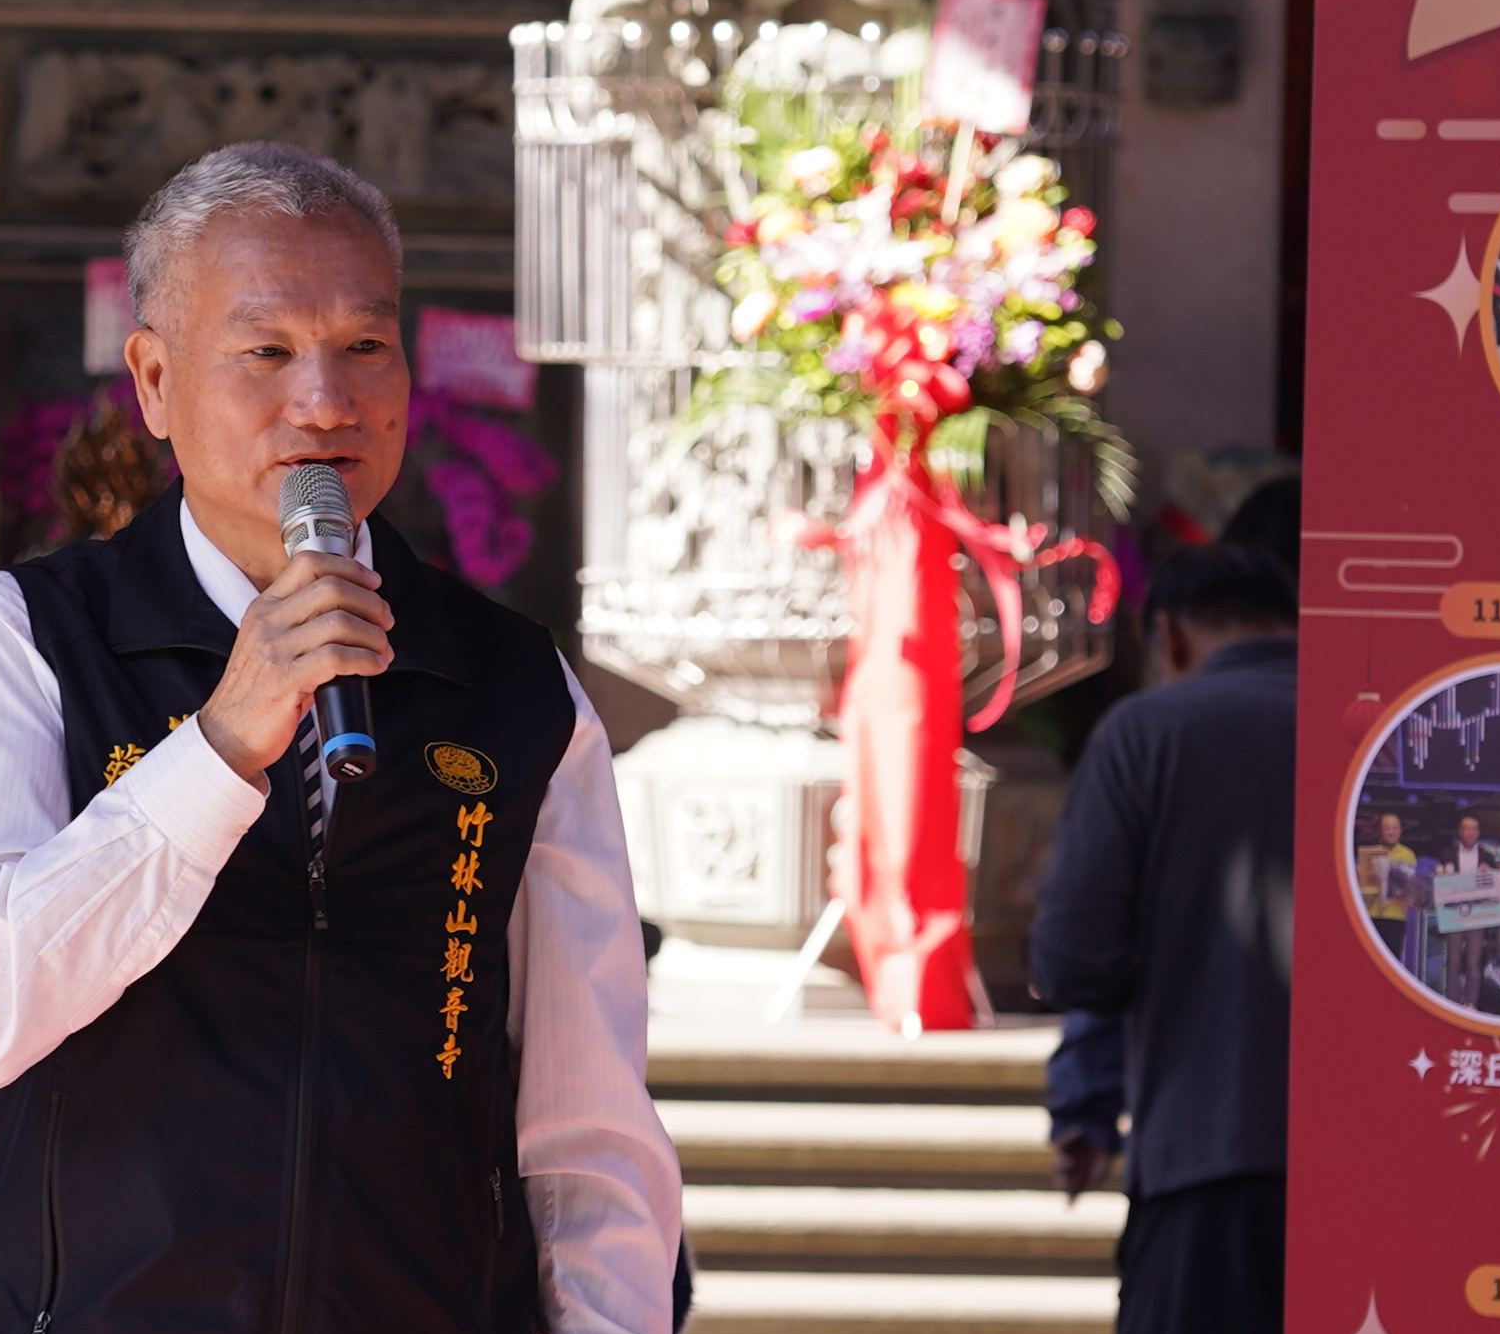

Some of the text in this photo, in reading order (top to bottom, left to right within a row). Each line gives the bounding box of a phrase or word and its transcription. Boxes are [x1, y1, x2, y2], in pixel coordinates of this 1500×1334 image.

[435, 801, 495, 1080] 竹林山觀音寺
